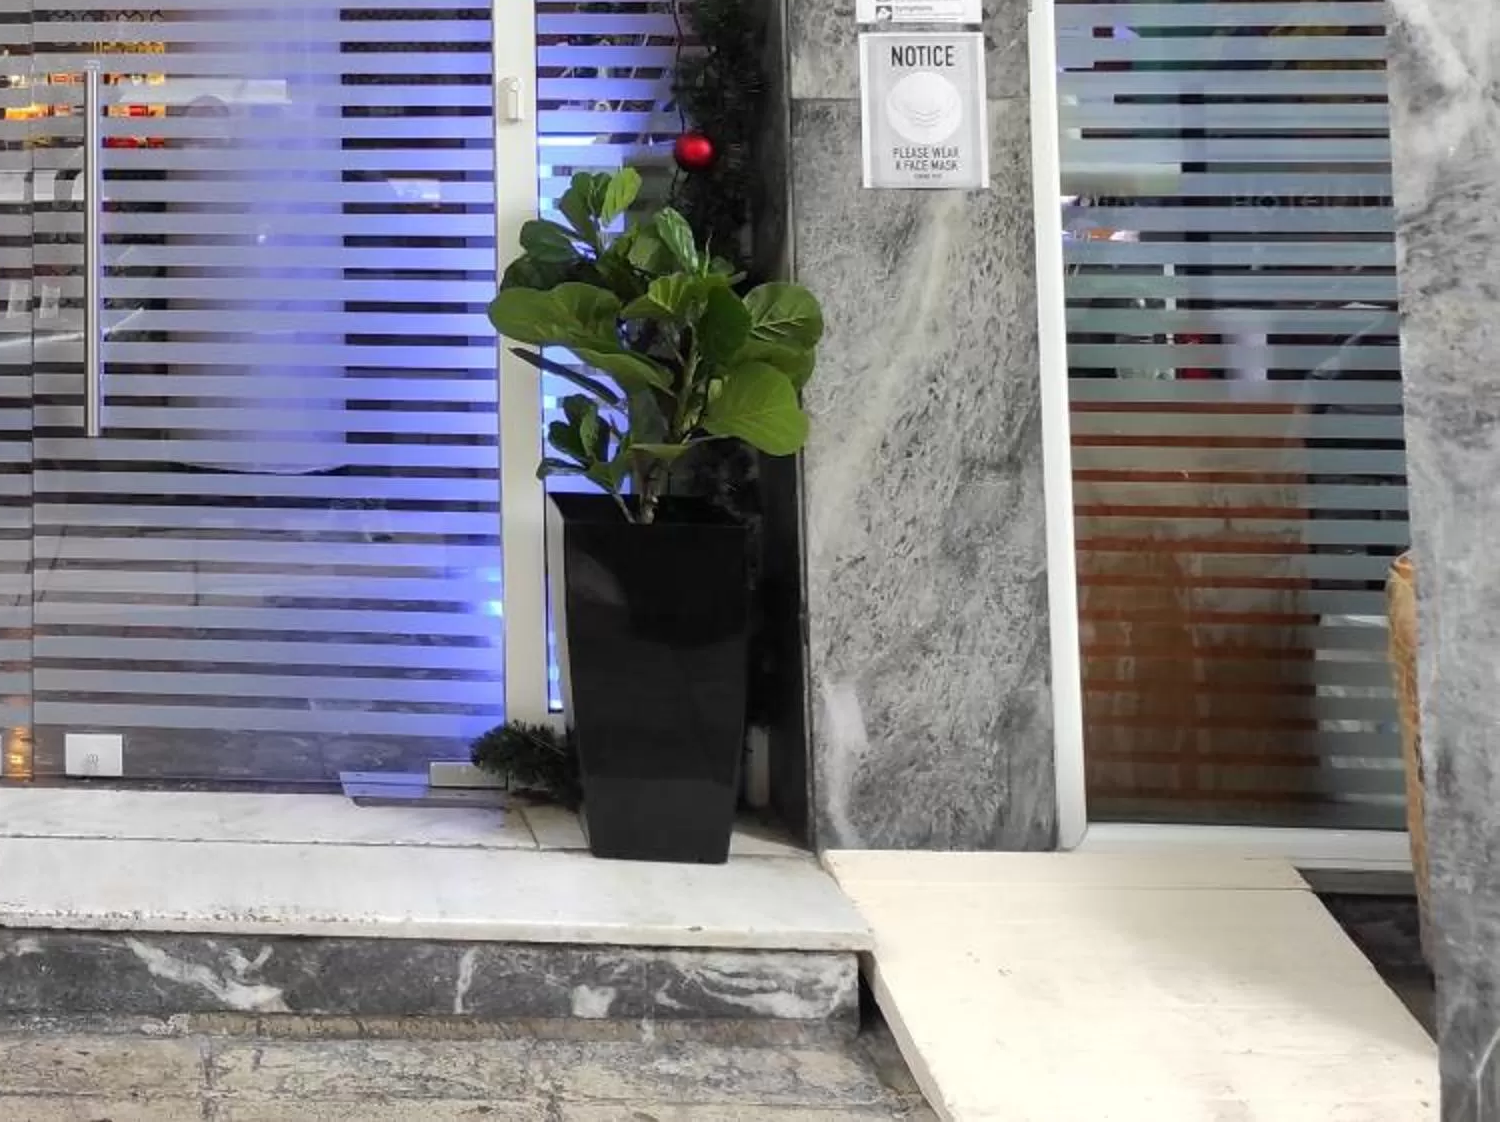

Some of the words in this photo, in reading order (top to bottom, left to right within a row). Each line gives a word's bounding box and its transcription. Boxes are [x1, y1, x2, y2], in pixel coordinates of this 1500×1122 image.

[891, 45, 955, 67] NOTICE
[892, 147, 929, 159] PLEASE
[903, 160, 929, 171] FACE
[930, 160, 959, 171] MASK
